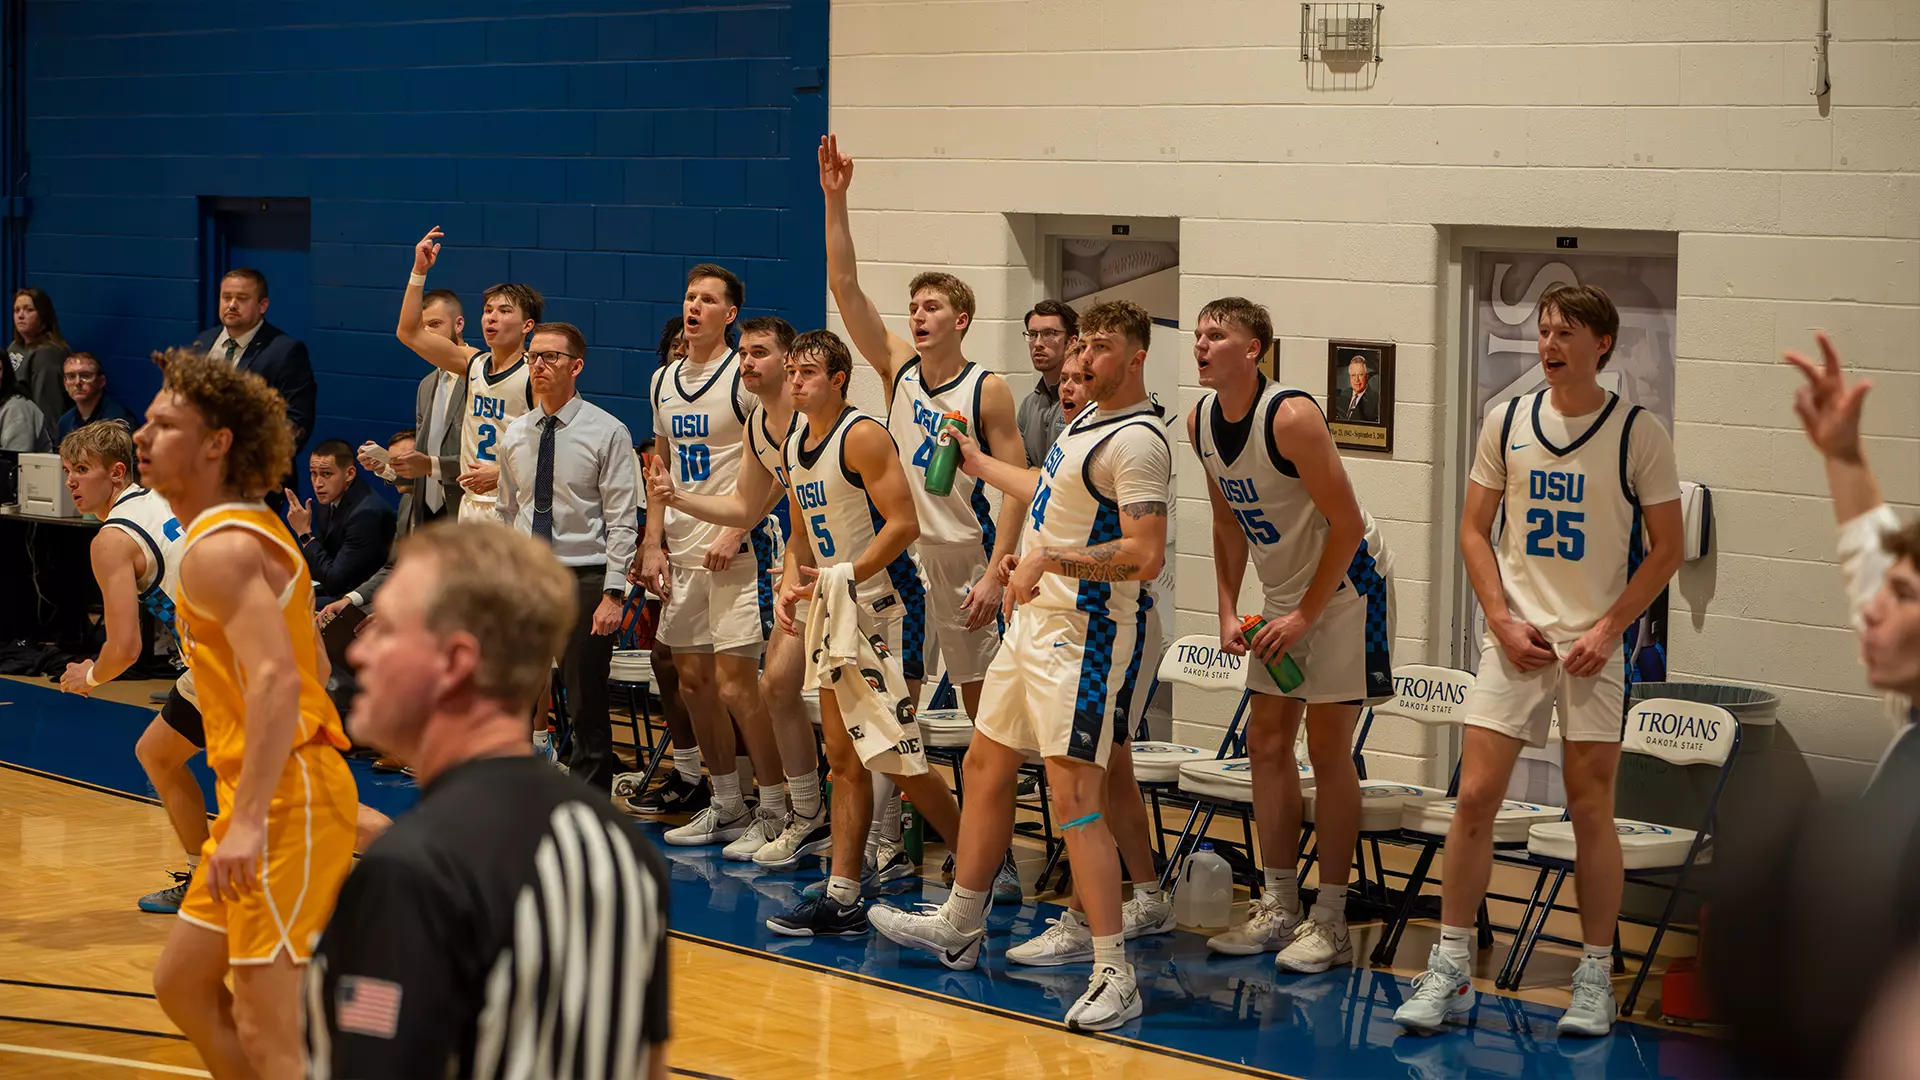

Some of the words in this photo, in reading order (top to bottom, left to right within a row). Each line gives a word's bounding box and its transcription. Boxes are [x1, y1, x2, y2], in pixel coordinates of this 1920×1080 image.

[473, 394, 505, 420] DSU
[913, 399, 945, 437] DSU
[672, 414, 709, 438] DSU
[476, 424, 497, 461] 2
[678, 444, 711, 482] 10
[1043, 442, 1065, 479] DSU
[796, 480, 827, 510] DSU
[1218, 476, 1259, 503] DSU
[1530, 470, 1585, 503] DSU
[810, 514, 835, 558] 5
[1526, 508, 1585, 561] 25
[1061, 559, 1127, 582] TEXAS
[1177, 645, 1241, 670] TROJANS
[1183, 666, 1209, 678] DAKOTA
[1211, 671, 1230, 679] STATE
[1393, 677, 1467, 705] TROJANS
[1399, 700, 1429, 712] DAKOTA
[1431, 705, 1452, 714] STATE
[1638, 712, 1720, 741] TROJANS
[1646, 736, 1678, 748] DAKOTA
[1681, 742, 1704, 751] STATE
